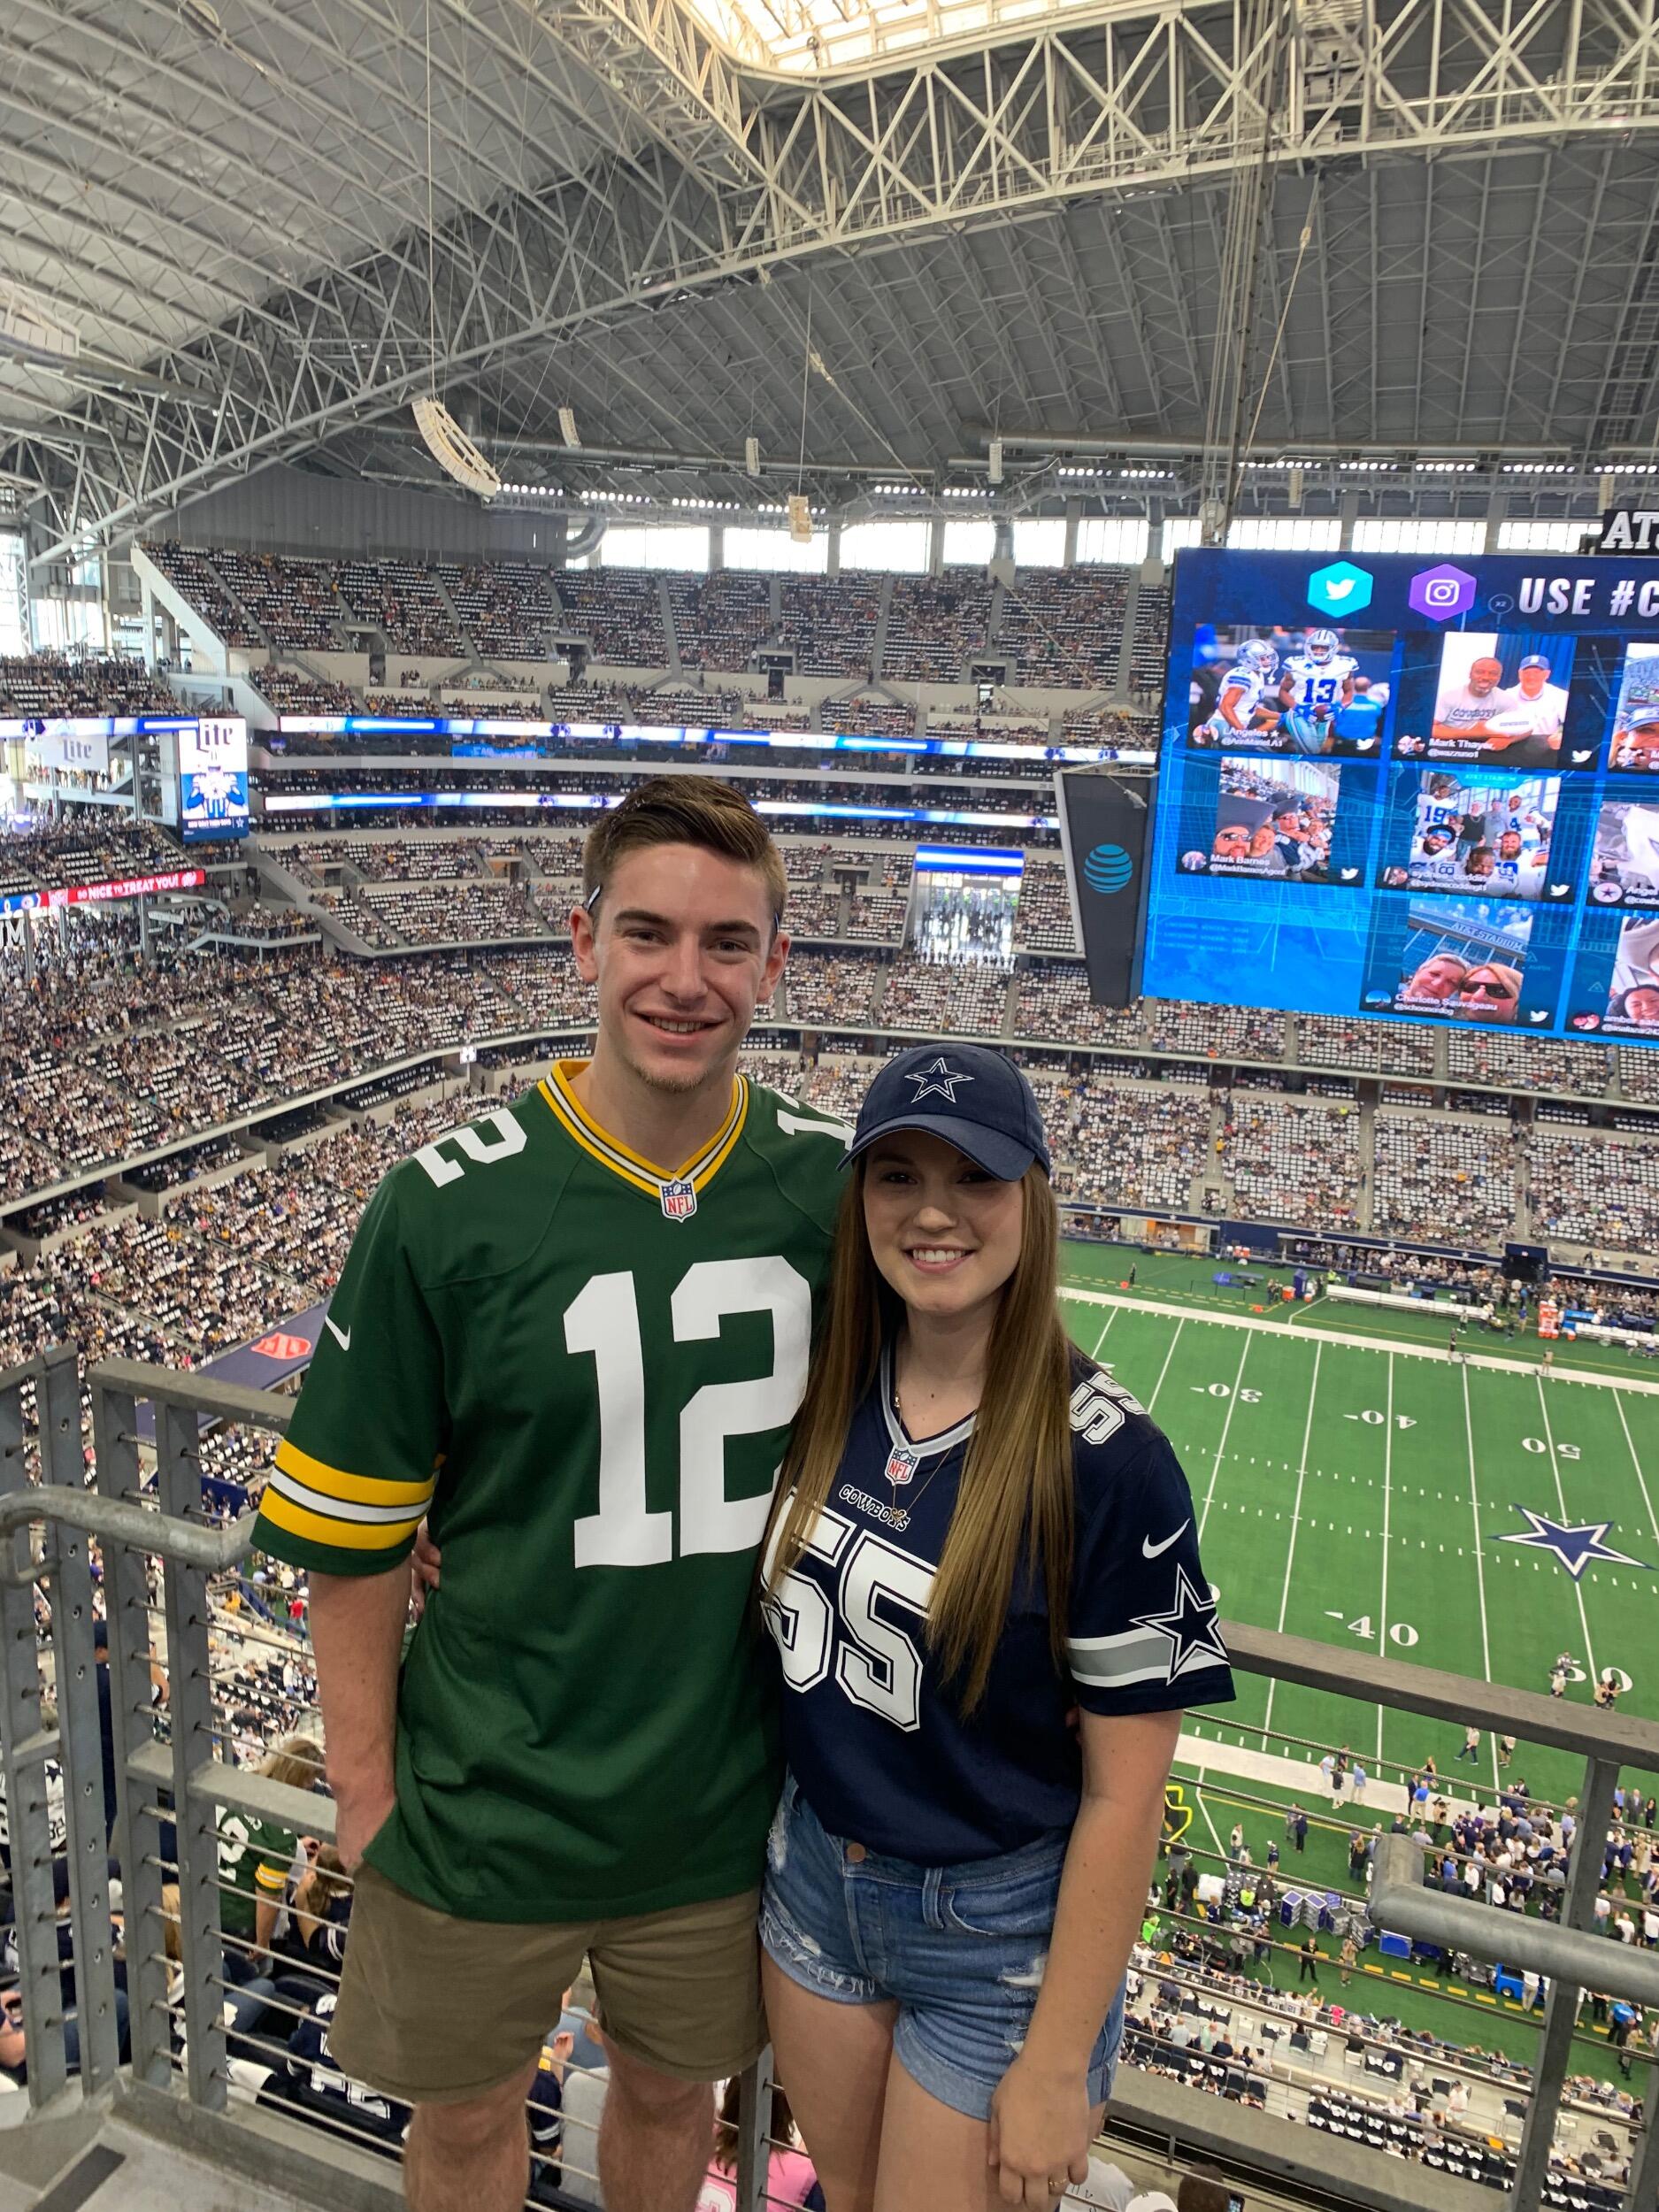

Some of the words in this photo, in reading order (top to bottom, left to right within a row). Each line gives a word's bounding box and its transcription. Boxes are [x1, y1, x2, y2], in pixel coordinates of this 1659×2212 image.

[1601, 511, 1659, 549] AT
[1519, 578, 1595, 614] USE
[1303, 678, 1338, 703] 13
[196, 719, 234, 754] Lite
[1429, 738, 1455, 749] Mark
[63, 740, 93, 763] Lite
[1425, 805, 1447, 824] 19
[1210, 854, 1234, 864] Mark
[88, 885, 113, 901] NICE
[122, 878, 155, 895] TREAT
[665, 1194, 693, 1216] NFL
[563, 1255, 812, 1569] 12
[888, 1460, 910, 1479] NFL
[759, 1486, 941, 1732] 55
[1347, 1616, 1419, 1646] 40
